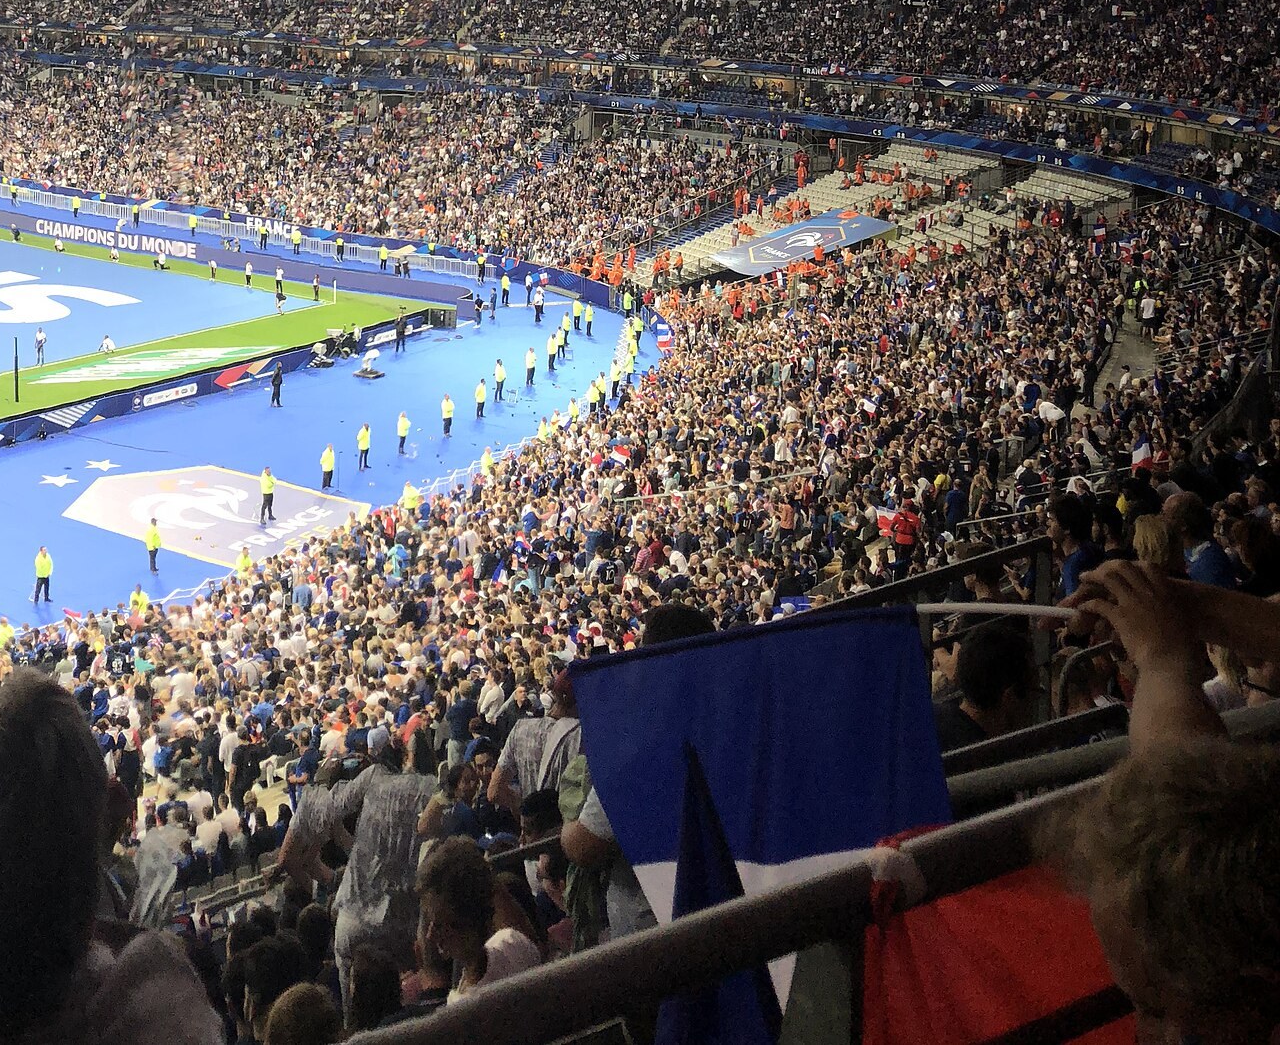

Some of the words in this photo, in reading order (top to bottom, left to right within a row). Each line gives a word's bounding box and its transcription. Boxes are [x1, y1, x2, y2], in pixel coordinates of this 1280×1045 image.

[803, 66, 823, 76] FRAN
[35, 218, 116, 247] CHAMPIONS
[117, 232, 139, 251] DU
[142, 236, 196, 259] MONDE
[227, 505, 334, 553] FRANCE
